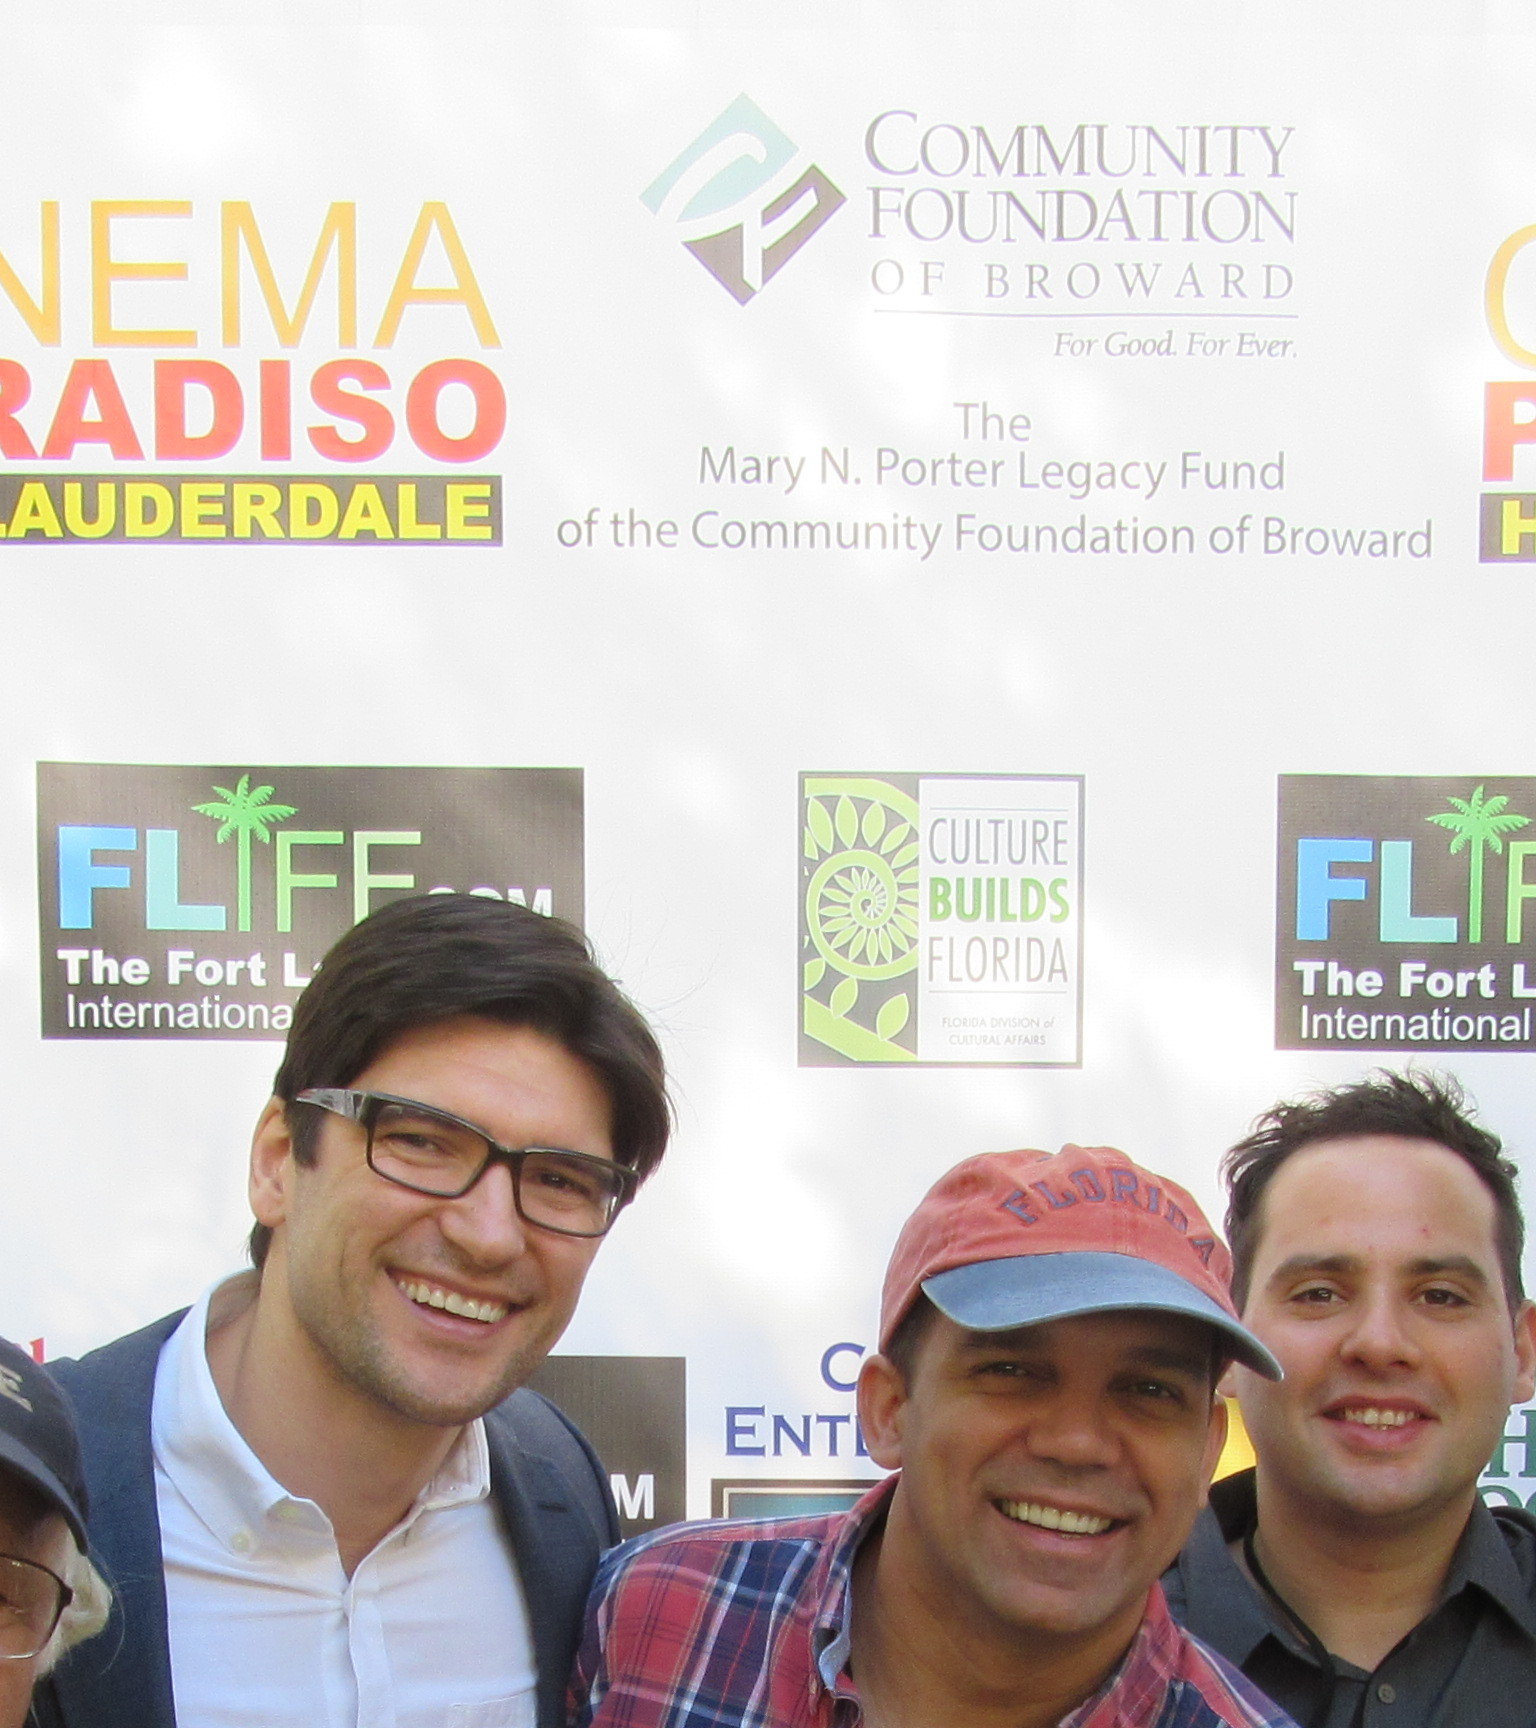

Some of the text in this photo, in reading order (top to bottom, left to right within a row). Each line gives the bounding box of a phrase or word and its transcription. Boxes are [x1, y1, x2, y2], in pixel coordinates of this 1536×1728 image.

[864, 110, 1297, 178] COMMUNITY
[867, 188, 1300, 244] FOUNDATION
[871, 261, 1294, 301] OF BROWARD
[1053, 330, 1300, 360] For Good. For Ever.
[953, 401, 1032, 442] The
[699, 445, 1286, 501] Mary N. Porter Legacy Fund
[556, 508, 1434, 561] of the Community Foundation of Broward
[928, 818, 1069, 865] CULTURE
[928, 877, 1070, 923] BUILDS
[58, 949, 151, 987] The
[167, 950, 266, 987] Fort
[928, 936, 1069, 982] FLORIDA
[1293, 961, 1383, 998] The
[1398, 963, 1495, 998] Fort
[1300, 1005, 1531, 1042] International
[999, 1168, 1217, 1271] FLORIDA
